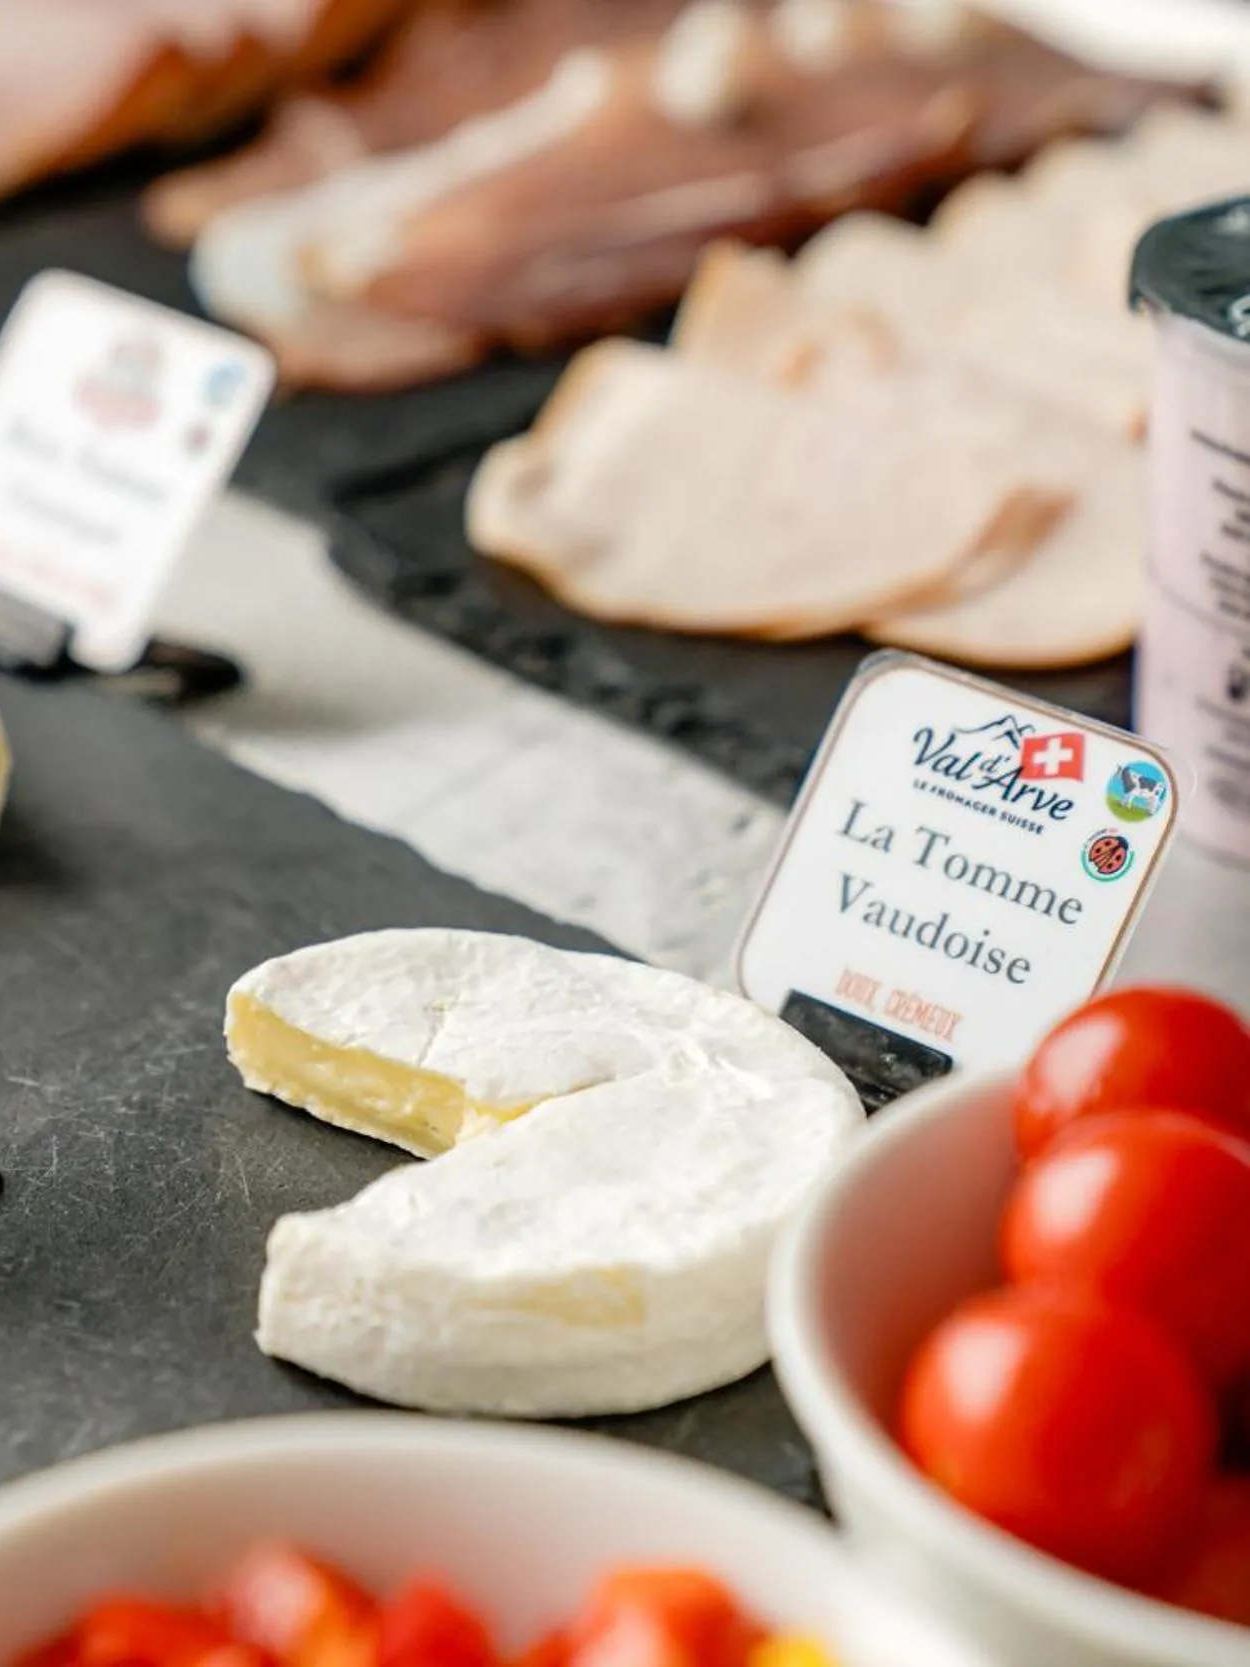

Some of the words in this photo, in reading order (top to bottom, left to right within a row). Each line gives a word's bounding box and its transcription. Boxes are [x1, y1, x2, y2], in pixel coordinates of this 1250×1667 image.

[913, 727, 982, 781] Val
[913, 779, 928, 790] LE
[930, 785, 997, 816] FROMAGER
[1000, 811, 1044, 834] SUISSE
[836, 802, 897, 853] La
[915, 826, 1085, 926] Tomme
[838, 872, 1033, 985] Vaudoise
